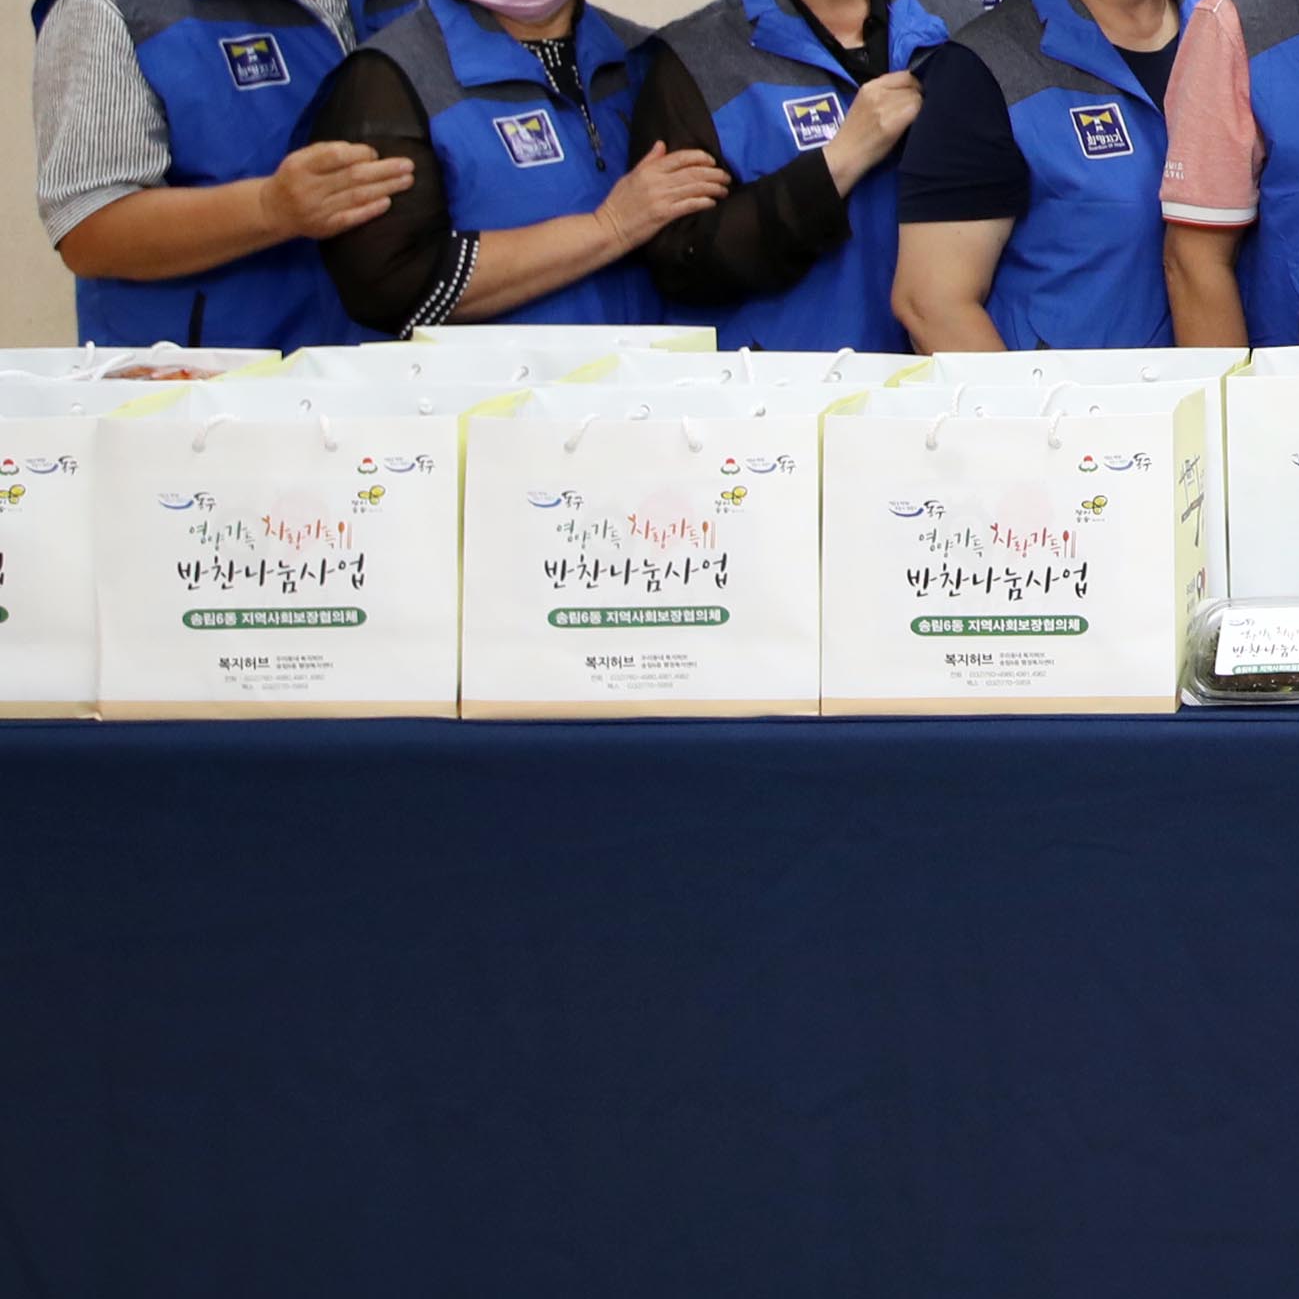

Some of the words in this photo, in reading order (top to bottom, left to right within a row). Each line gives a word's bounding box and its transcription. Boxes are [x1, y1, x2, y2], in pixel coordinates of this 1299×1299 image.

[177, 554, 365, 594] 반찬나눔사업
[545, 553, 728, 593] 반찬나눔사업
[907, 562, 1088, 600] 반찬나눔사업
[218, 655, 271, 671] 복지허브
[585, 655, 635, 669] 복지허브
[945, 653, 994, 666] 복지허브
